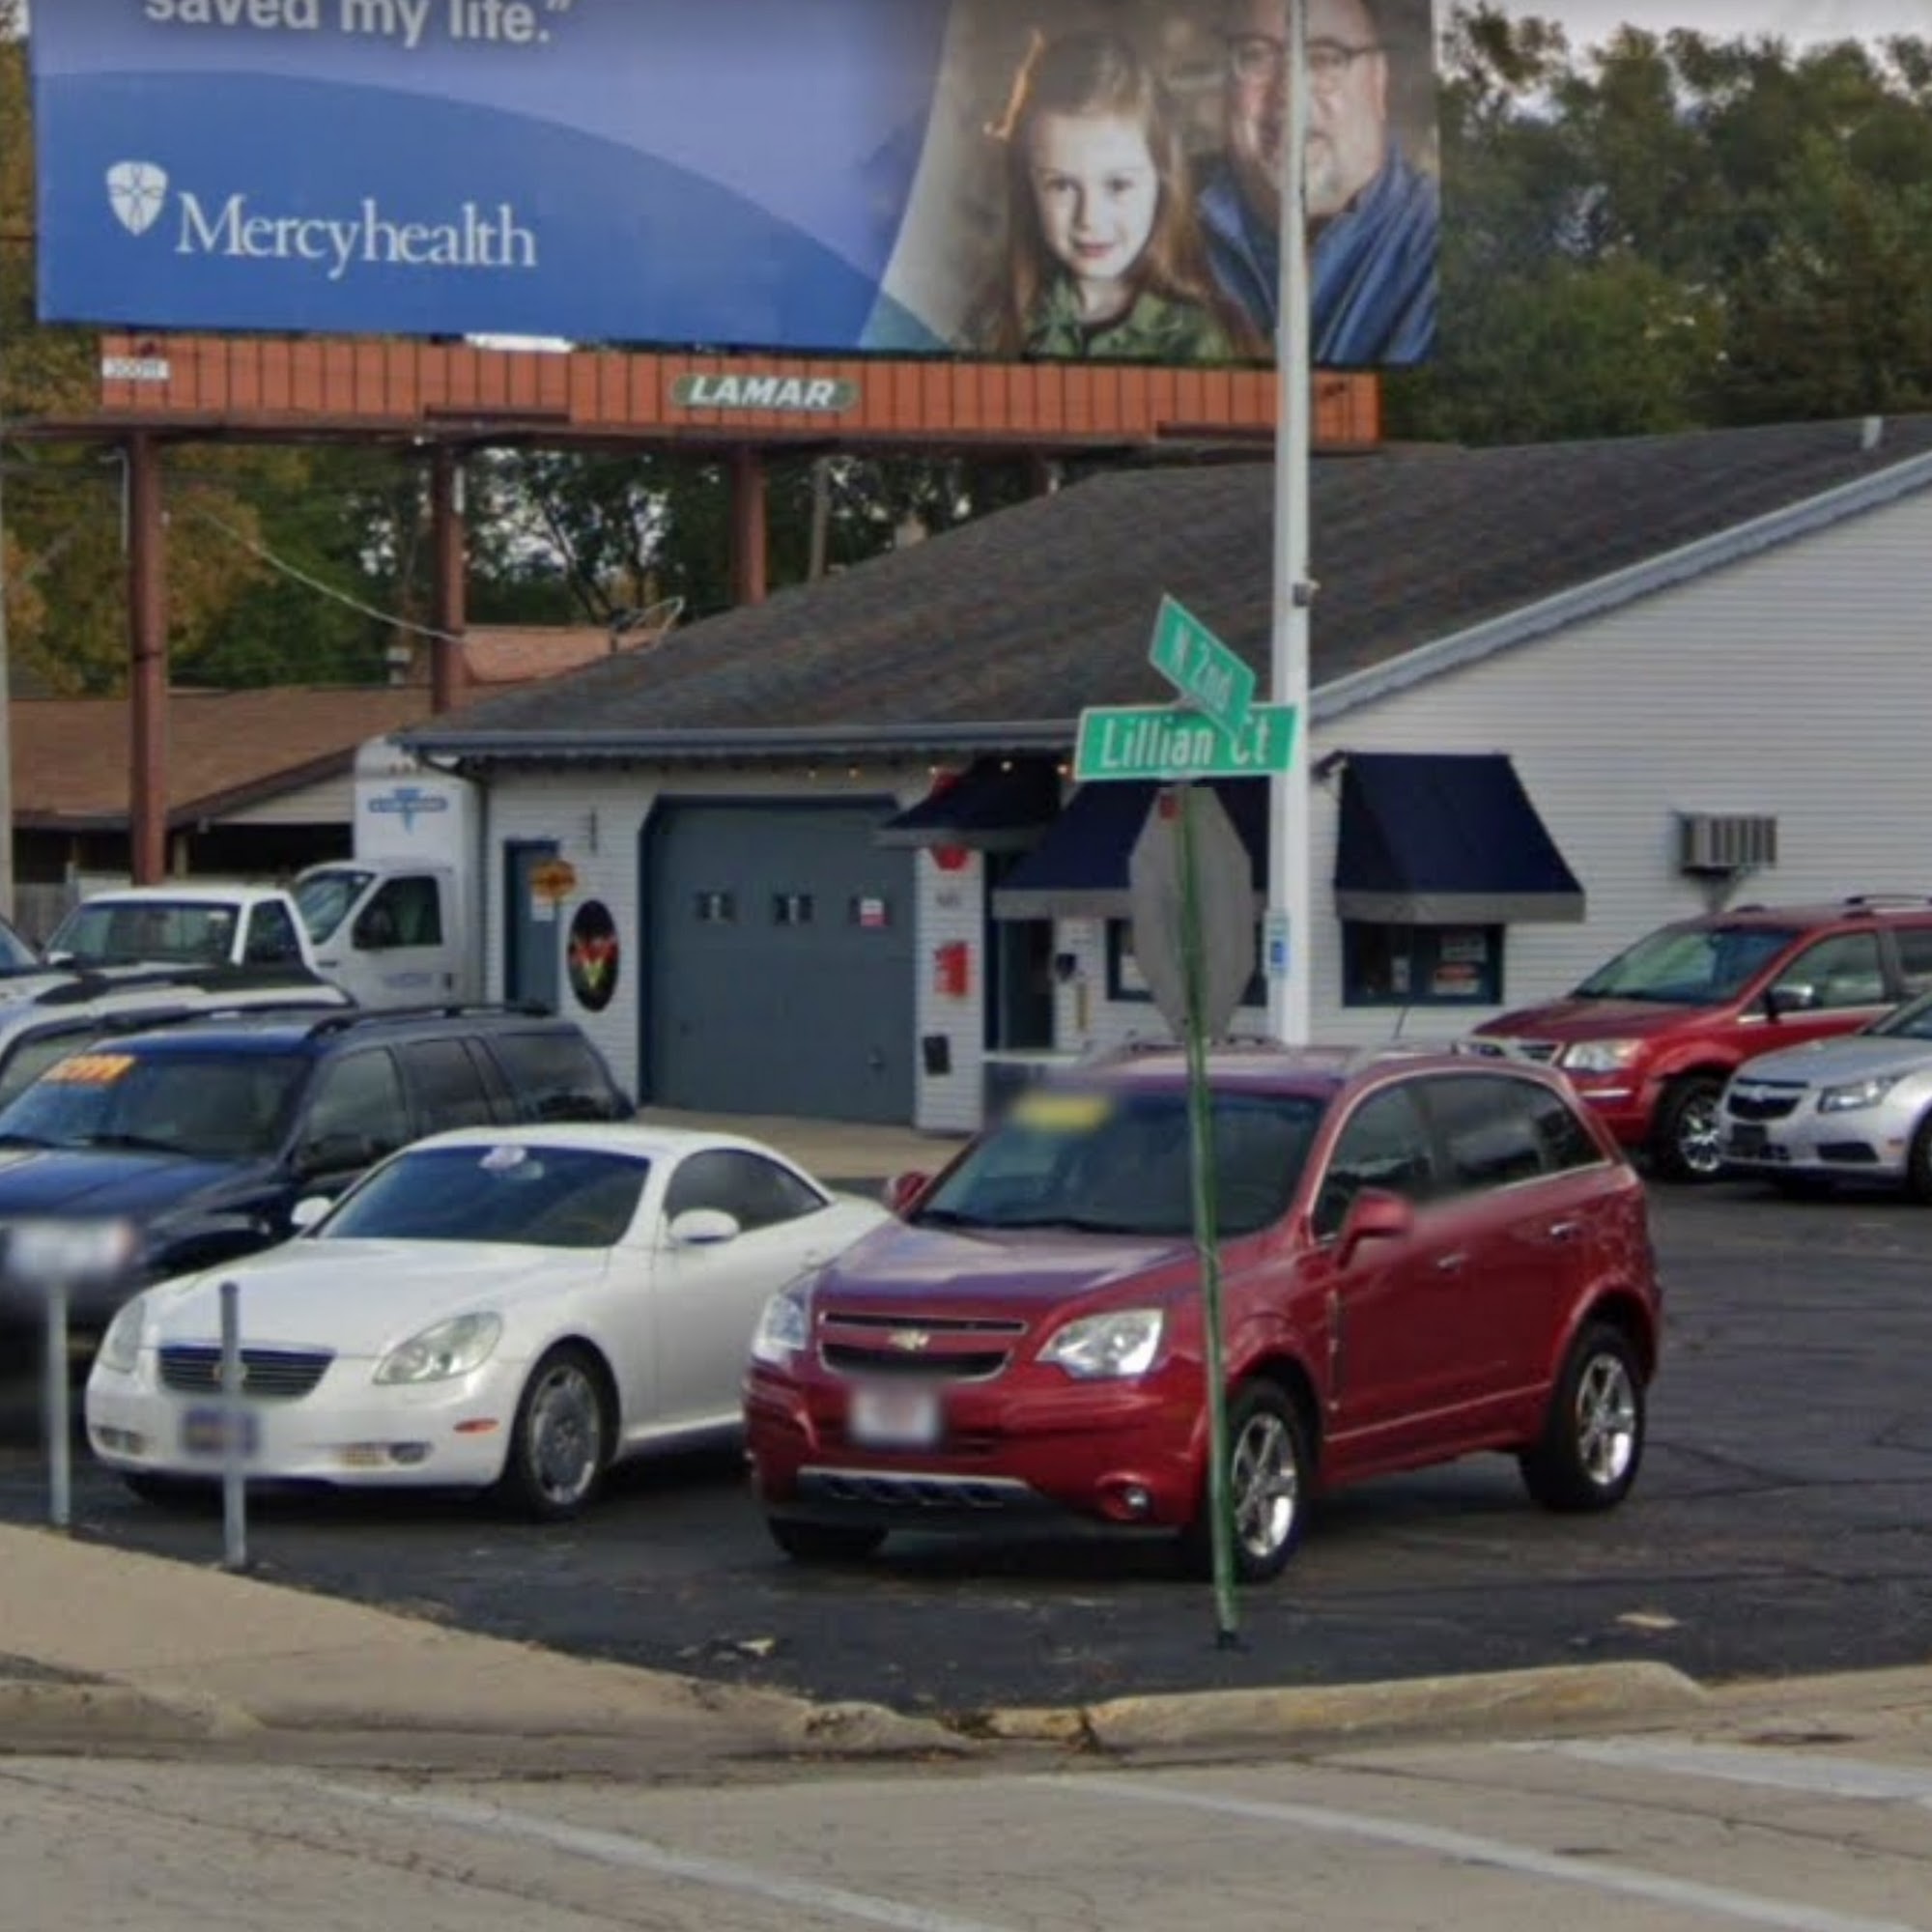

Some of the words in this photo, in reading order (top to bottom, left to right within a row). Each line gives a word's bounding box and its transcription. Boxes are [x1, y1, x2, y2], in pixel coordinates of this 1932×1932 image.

[340, 0, 429, 48] my
[175, 192, 538, 280] Mercyhealth
[689, 375, 837, 409] LAMAR
[1166, 621, 1191, 678] N
[1100, 715, 1215, 769] Lillian
[1230, 711, 1270, 766] Ct
